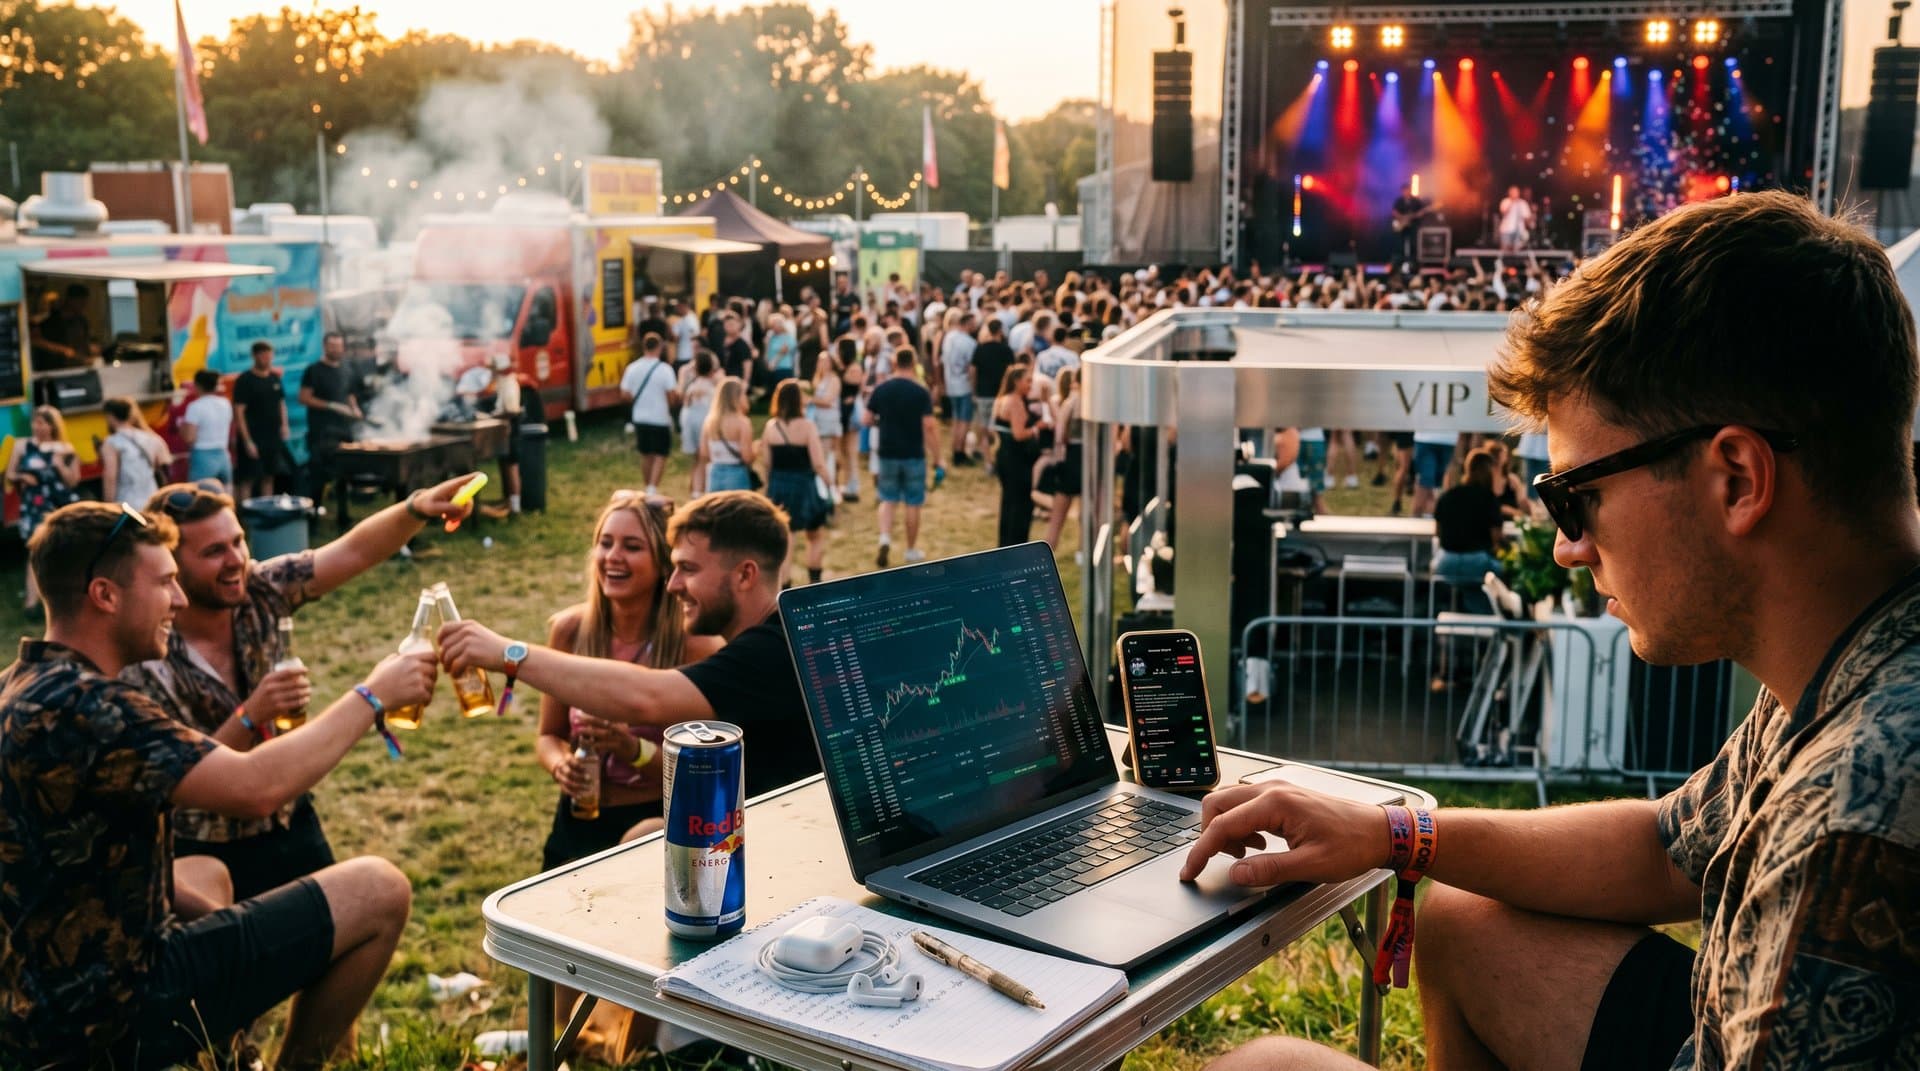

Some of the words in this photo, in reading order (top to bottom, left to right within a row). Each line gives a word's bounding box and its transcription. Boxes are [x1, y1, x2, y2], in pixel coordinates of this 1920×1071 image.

[1393, 381, 1471, 417] VIP
[688, 812, 731, 836] Red
[734, 809, 745, 831] B
[691, 857, 731, 868] ENERG
